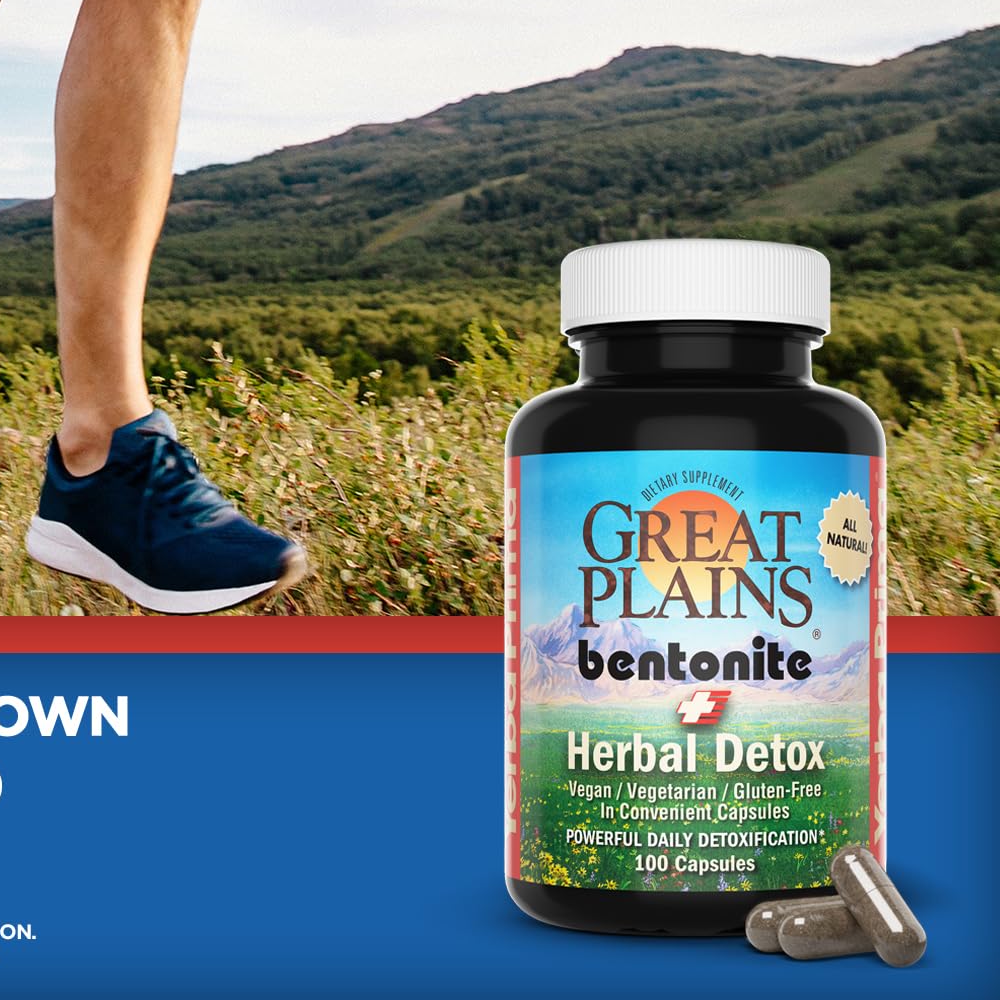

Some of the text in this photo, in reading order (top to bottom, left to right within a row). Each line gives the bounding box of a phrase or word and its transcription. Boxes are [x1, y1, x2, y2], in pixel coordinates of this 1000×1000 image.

[641, 470, 745, 502] DIETARY SUPPLEMENT
[583, 500, 802, 564] GREAT
[843, 518, 857, 533] ALL
[826, 532, 868, 554] NATURAL!
[578, 565, 813, 628] PLAINS
[578, 635, 813, 682] bentonite
[566, 731, 826, 773] Herbal Detox
[568, 780, 612, 801] Vegan
[627, 782, 717, 803] Vegetarian
[733, 781, 822, 800] Gluten-Free
[601, 802, 790, 824] In Convenient Capsules
[566, 829, 643, 847] POWERFUL
[647, 832, 693, 848] DAILY
[635, 854, 756, 876] 100 Capsules
